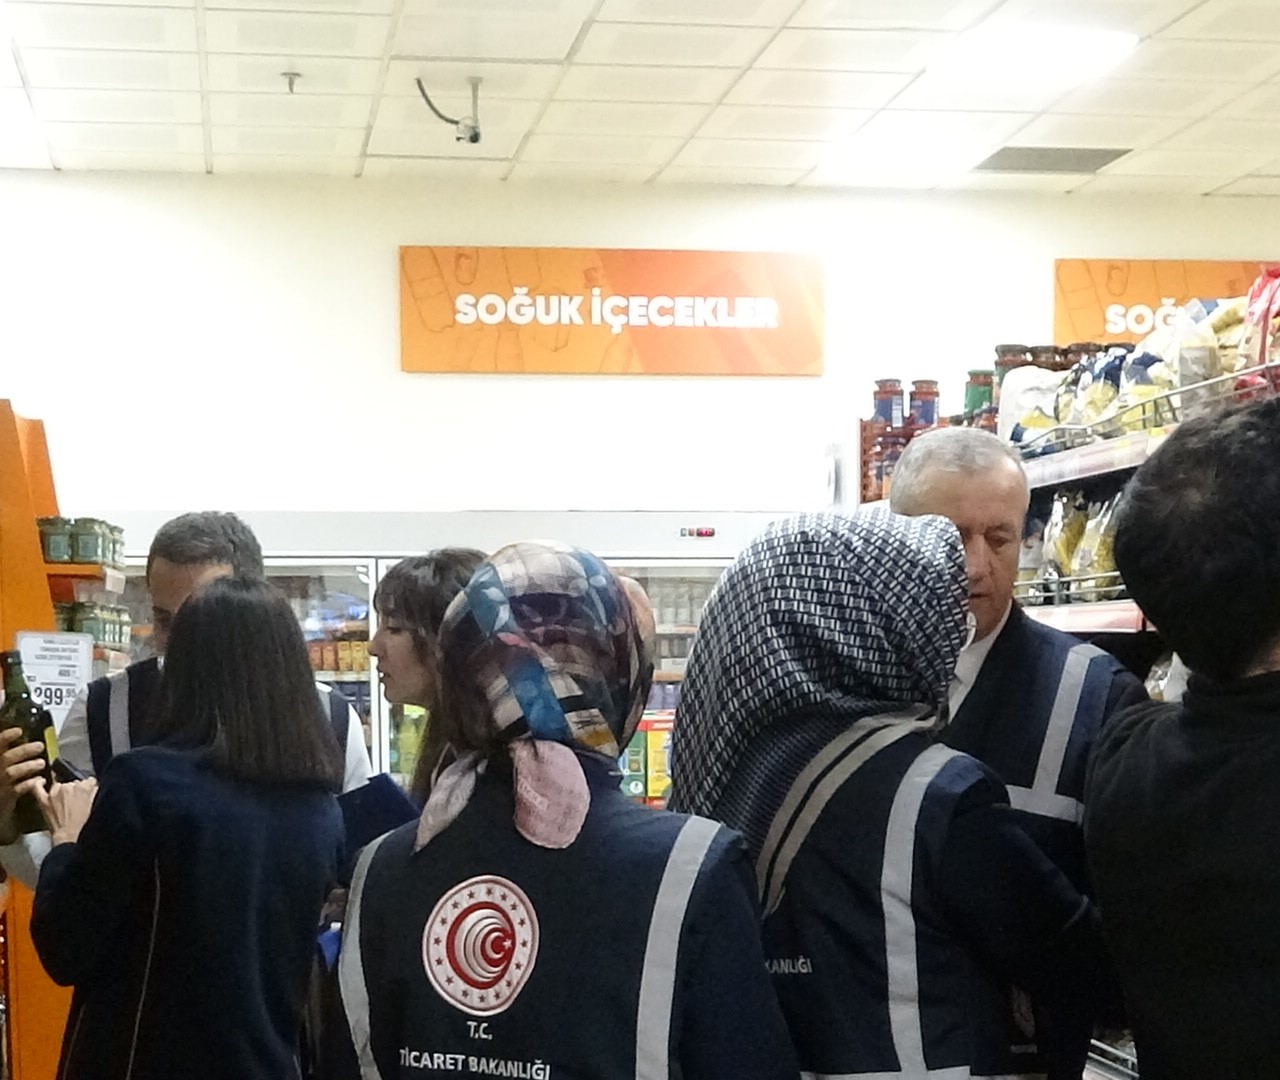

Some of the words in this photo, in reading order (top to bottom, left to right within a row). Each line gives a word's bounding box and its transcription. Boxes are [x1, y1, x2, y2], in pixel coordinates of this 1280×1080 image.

[455, 286, 584, 326] SOĞUK
[590, 287, 779, 334] İÇECEKLER
[1105, 299, 1178, 335] SOĞ
[765, 956, 813, 975] KANLIĞI
[466, 1021, 494, 1041] T.C.
[400, 1047, 466, 1072] TİCARET
